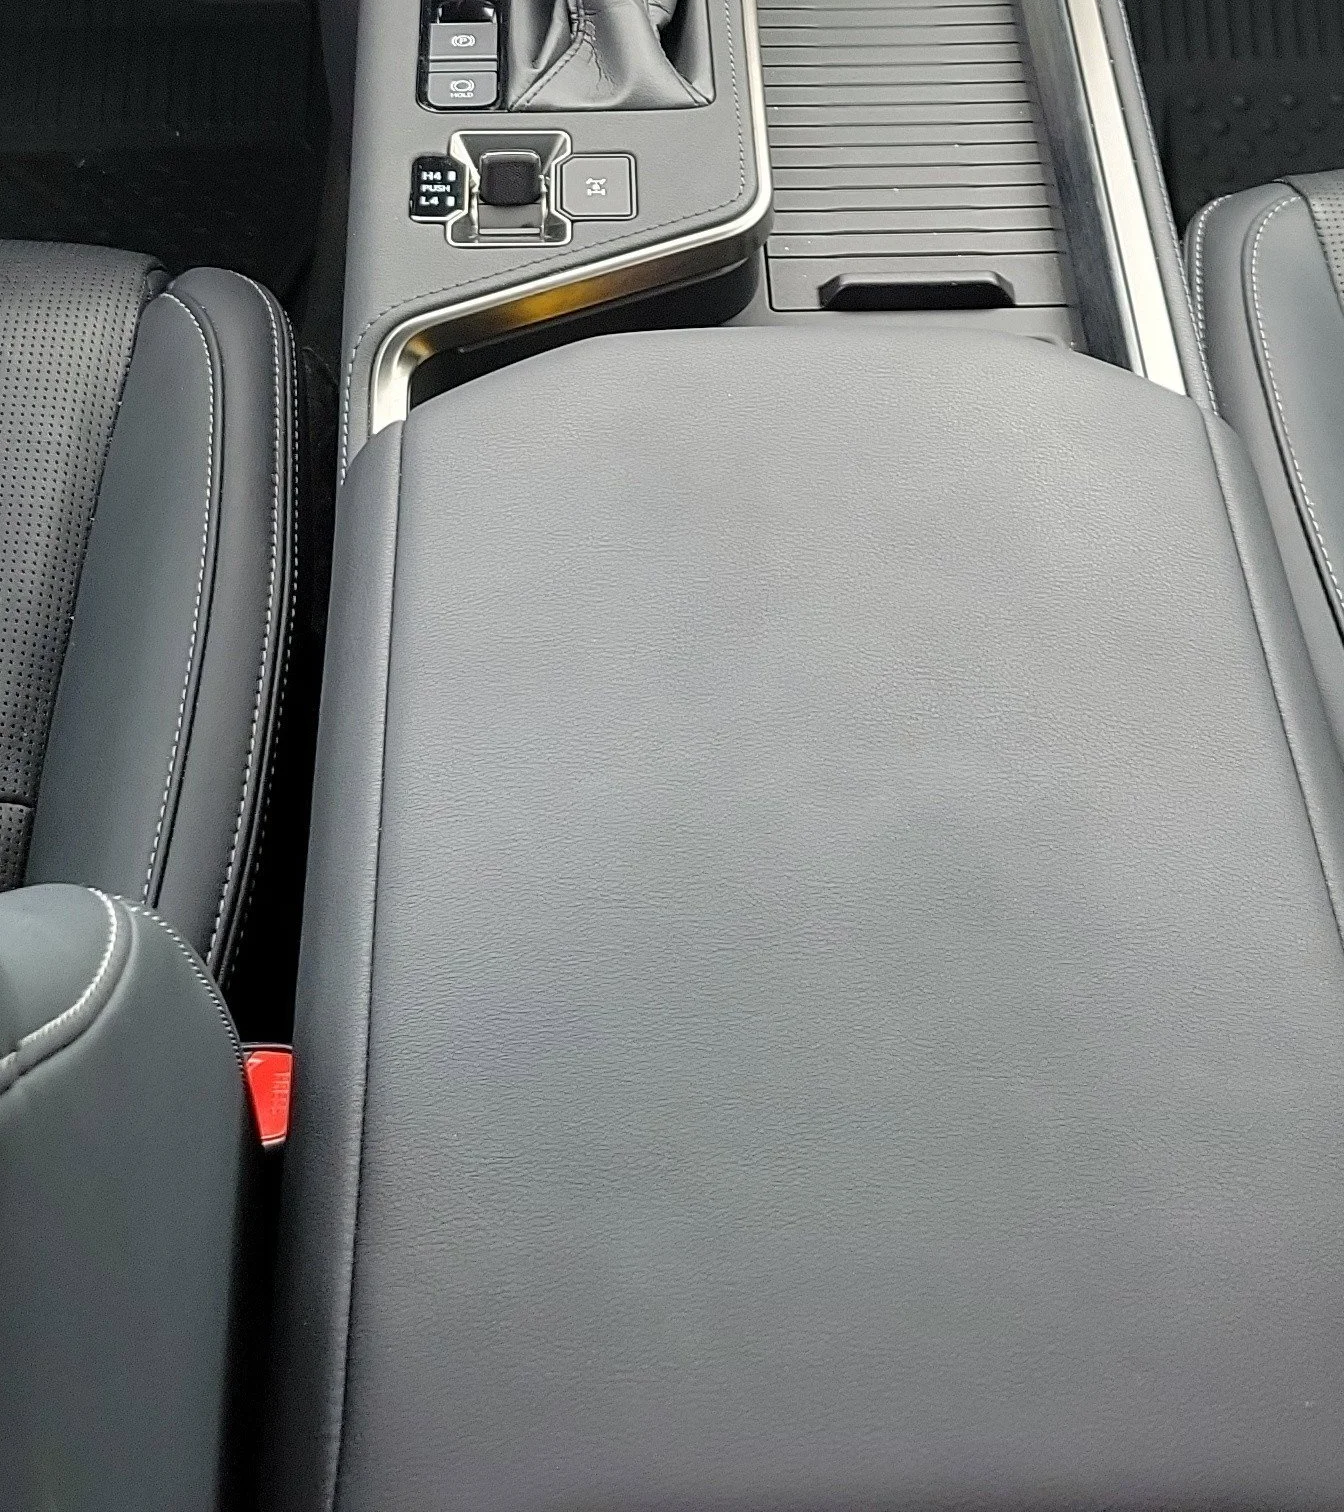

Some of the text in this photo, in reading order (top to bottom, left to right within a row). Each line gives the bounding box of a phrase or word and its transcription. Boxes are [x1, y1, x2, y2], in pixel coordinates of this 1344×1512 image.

[421, 171, 442, 181] H4
[419, 184, 451, 192] PUSH
[419, 196, 440, 206] L4
